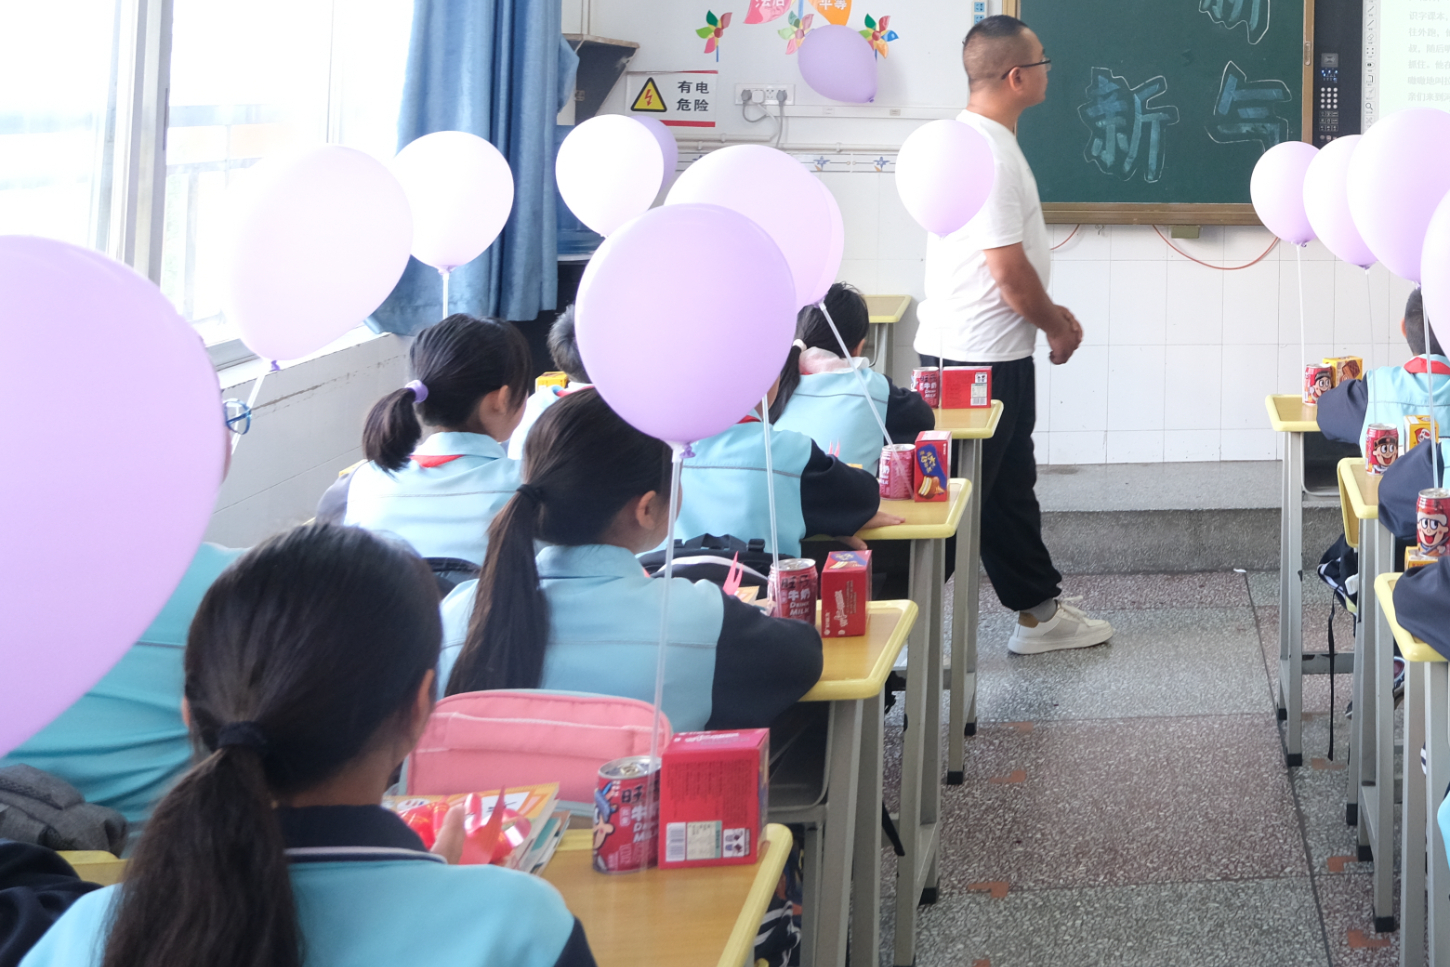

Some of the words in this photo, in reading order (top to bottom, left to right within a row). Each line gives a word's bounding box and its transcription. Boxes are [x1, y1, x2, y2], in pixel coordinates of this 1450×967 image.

[677, 80, 709, 94] 有电
[676, 98, 709, 112] 危险
[788, 588, 810, 602] 牛奶
